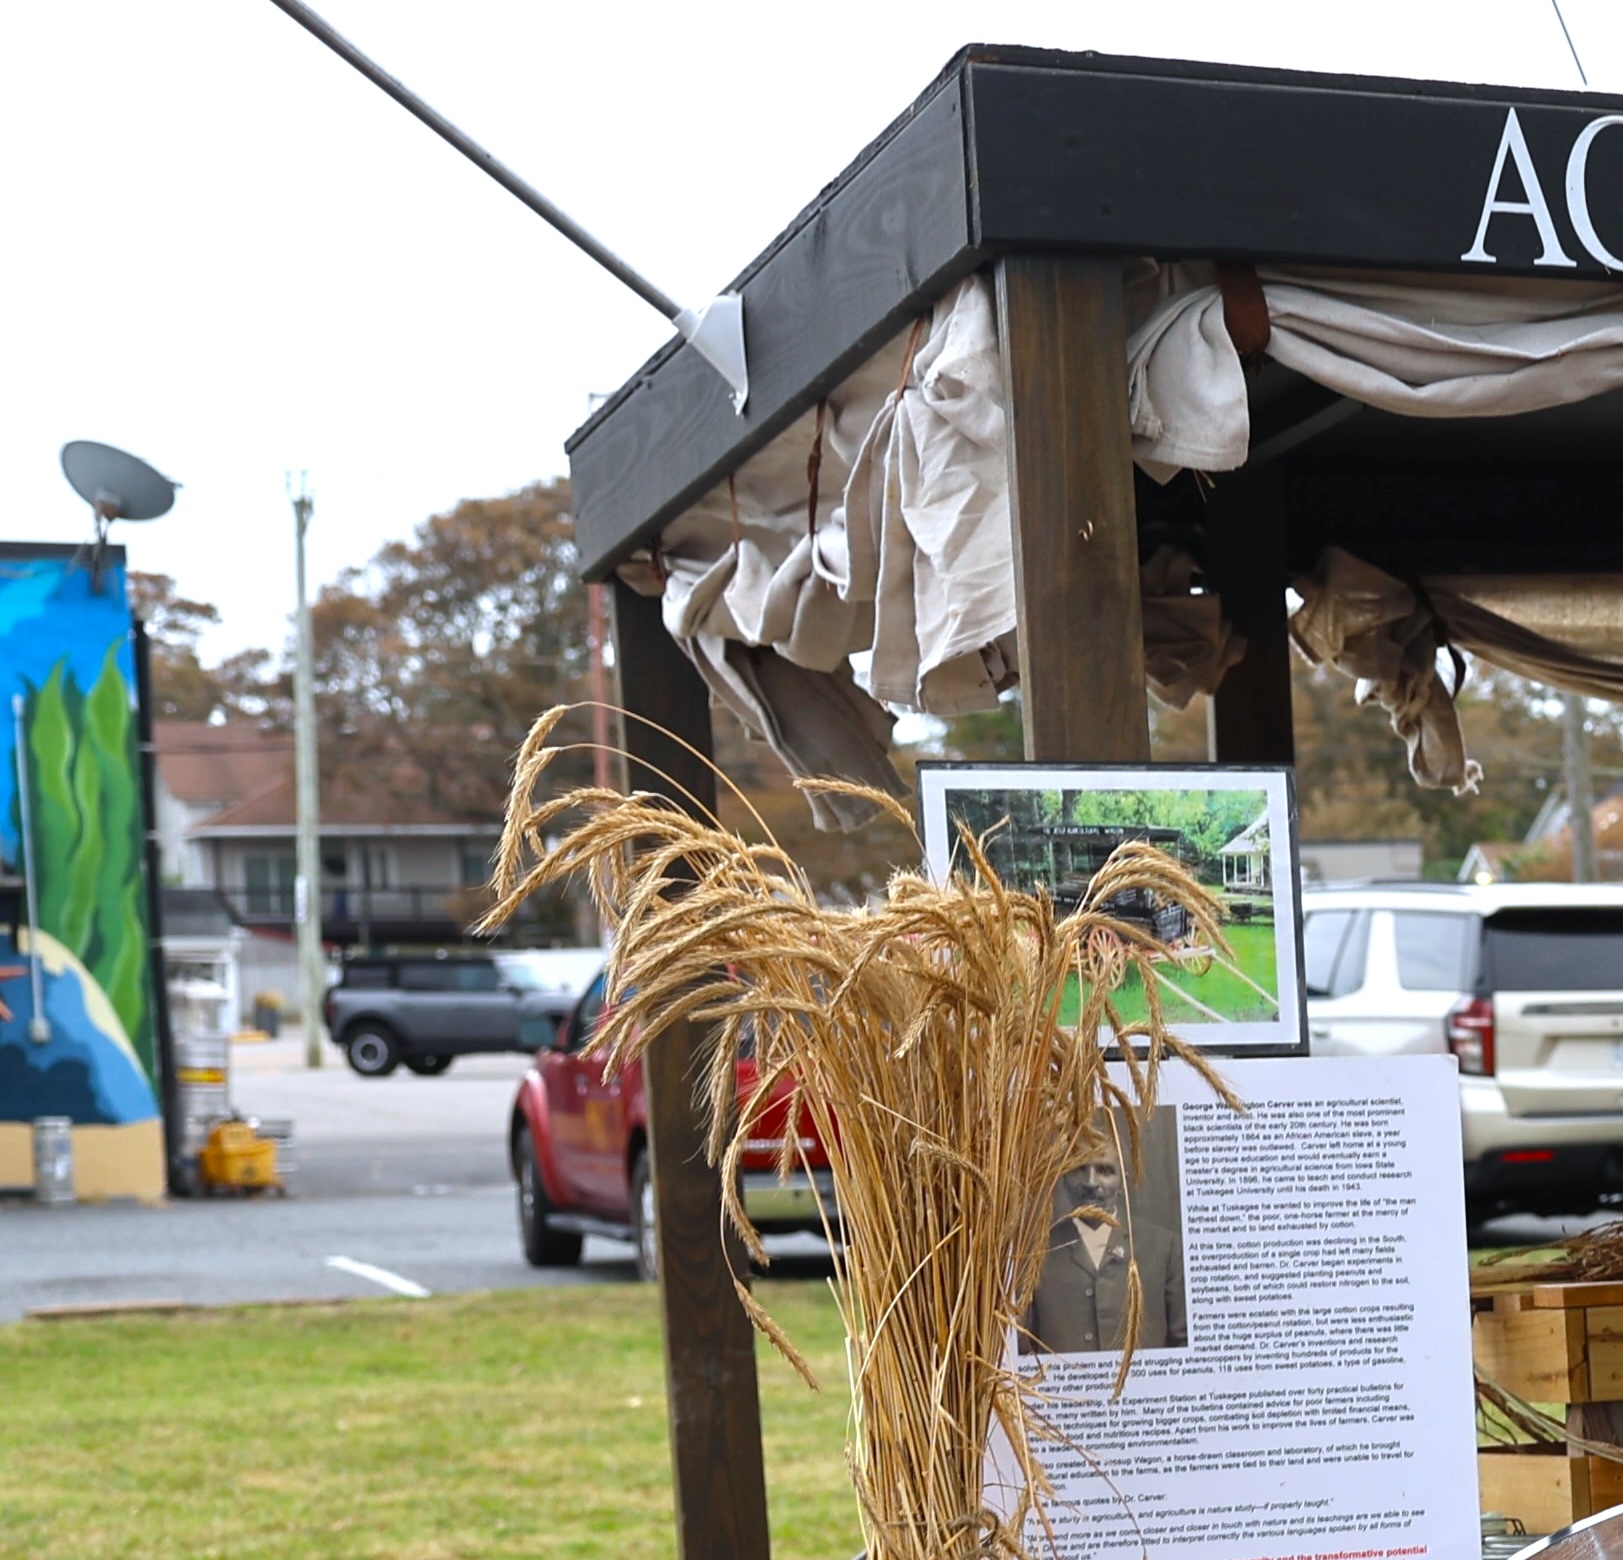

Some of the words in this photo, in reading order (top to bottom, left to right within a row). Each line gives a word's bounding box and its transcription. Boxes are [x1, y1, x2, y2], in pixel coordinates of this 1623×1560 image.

[1182, 1102, 1213, 1112] George
[1267, 1100, 1294, 1108] Carver
[1326, 1098, 1368, 1108] agricultural
[1314, 1549, 1383, 1560] transformative
[1386, 1545, 1427, 1558] potential
